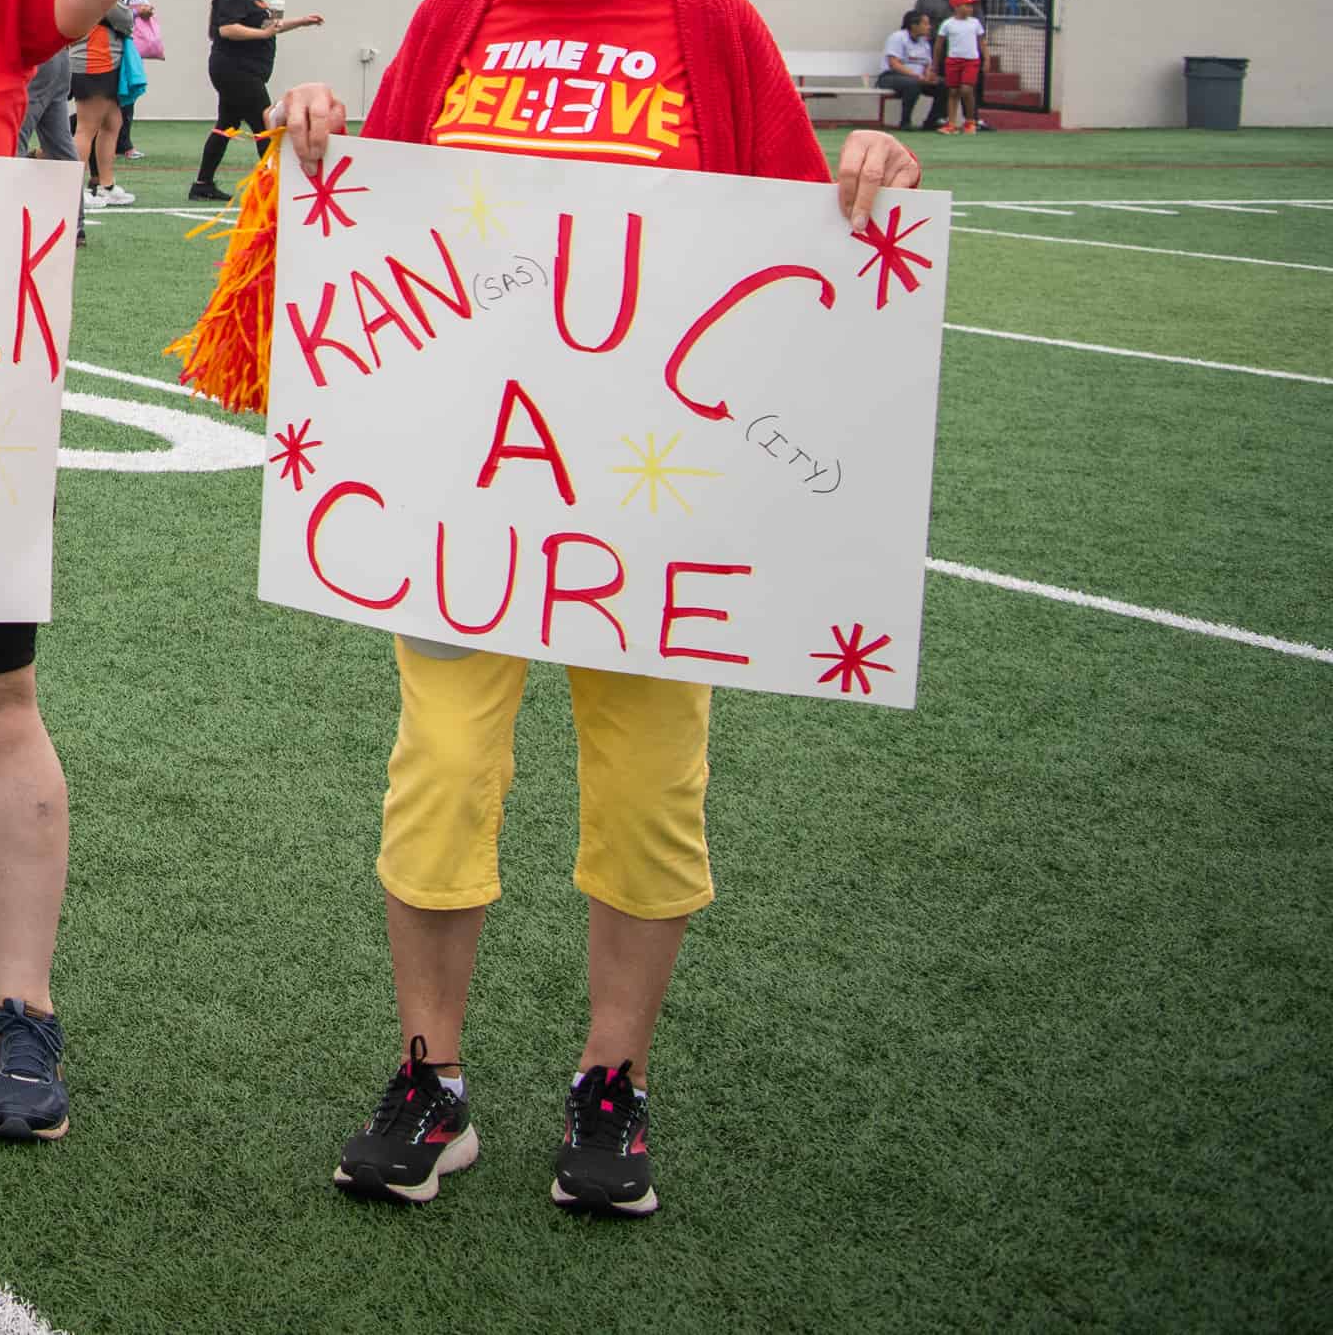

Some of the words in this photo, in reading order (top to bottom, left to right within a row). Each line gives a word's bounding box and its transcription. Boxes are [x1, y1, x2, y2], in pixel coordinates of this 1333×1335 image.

[482, 39, 589, 71] TIME
[596, 44, 657, 79] TO
[285, 228, 472, 387] KAN
[553, 212, 642, 354] U
[664, 264, 836, 421] C
[475, 378, 576, 506] A
[306, 480, 753, 665] CURE
